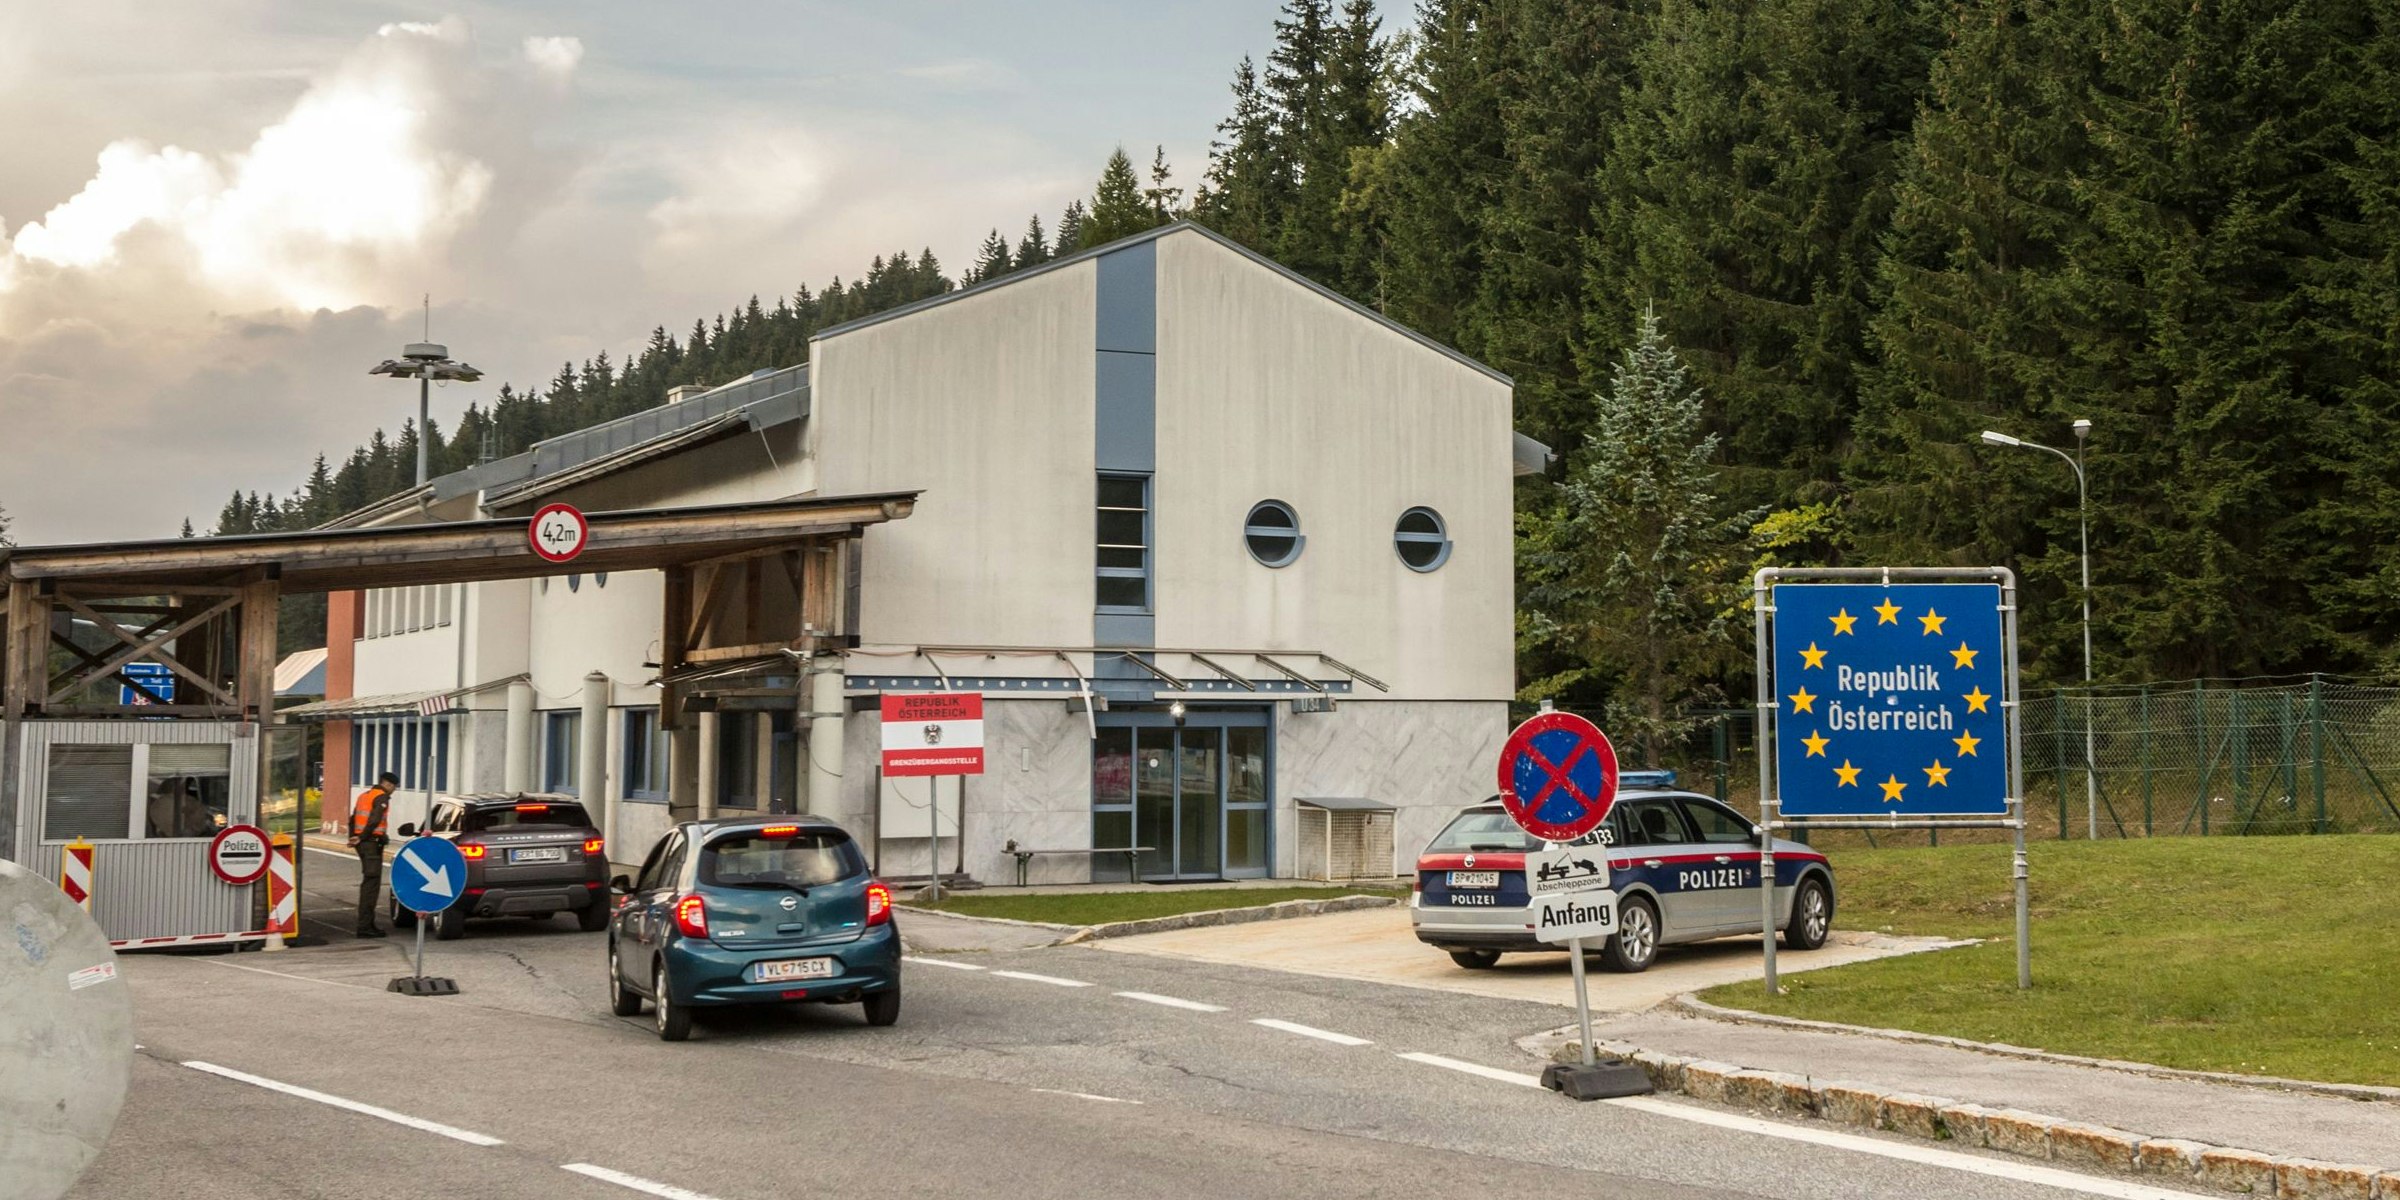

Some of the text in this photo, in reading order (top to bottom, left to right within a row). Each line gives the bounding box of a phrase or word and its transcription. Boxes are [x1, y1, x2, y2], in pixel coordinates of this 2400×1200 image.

[543, 521, 576, 545] 4,2m
[1838, 664, 1941, 698] Republik
[904, 697, 960, 708] REPUBLIK
[898, 707, 967, 719] ÖSTERREICH
[1828, 700, 1953, 731] Österreich
[223, 839, 259, 851] Polizei
[1536, 876, 1602, 892] Abschleppzone
[1679, 868, 1743, 890] POLIZEI
[1451, 894, 1496, 905] POLIZEI
[1541, 901, 1611, 928] Anfang
[811, 961, 827, 972] CX
